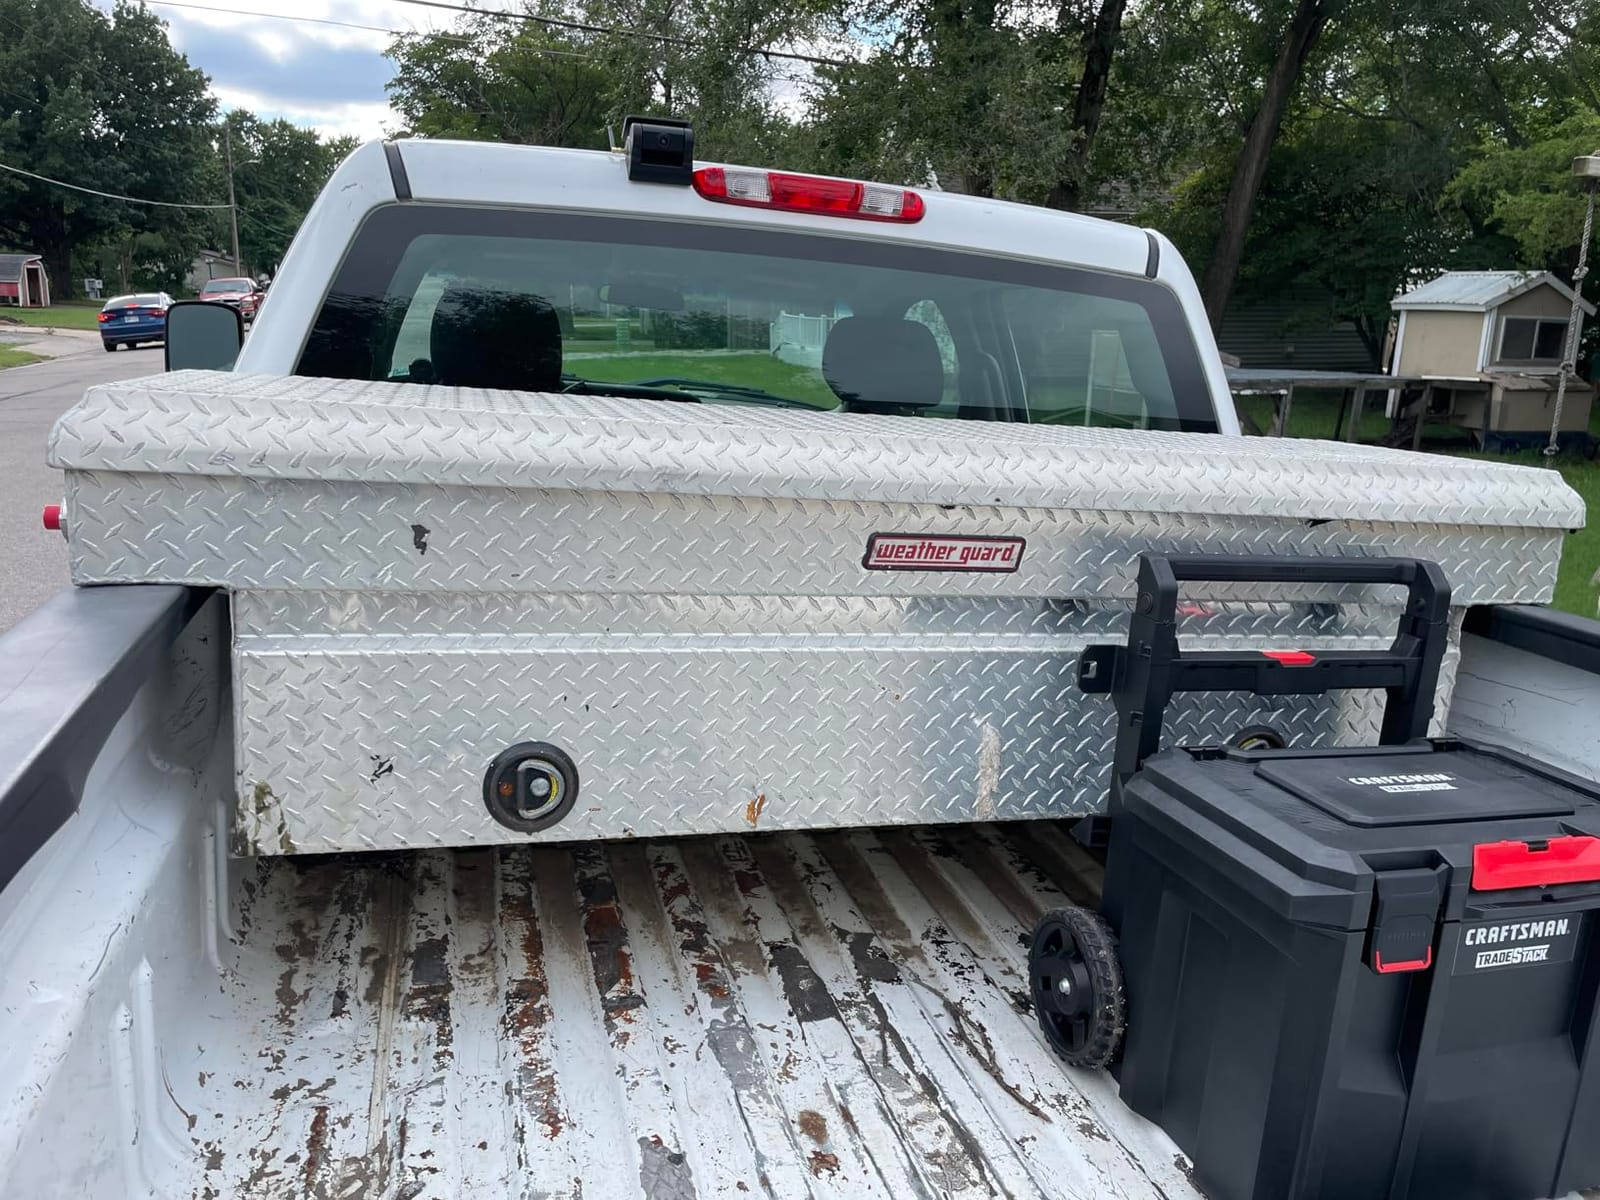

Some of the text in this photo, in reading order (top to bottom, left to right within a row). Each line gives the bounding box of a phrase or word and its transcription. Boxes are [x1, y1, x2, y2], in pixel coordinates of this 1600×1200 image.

[876, 541, 1016, 564] weather guard
[1348, 773, 1453, 785] CRAFTSMAN
[1465, 918, 1569, 946] CRAFTSMAN
[1475, 944, 1551, 969] TRADESTACK
